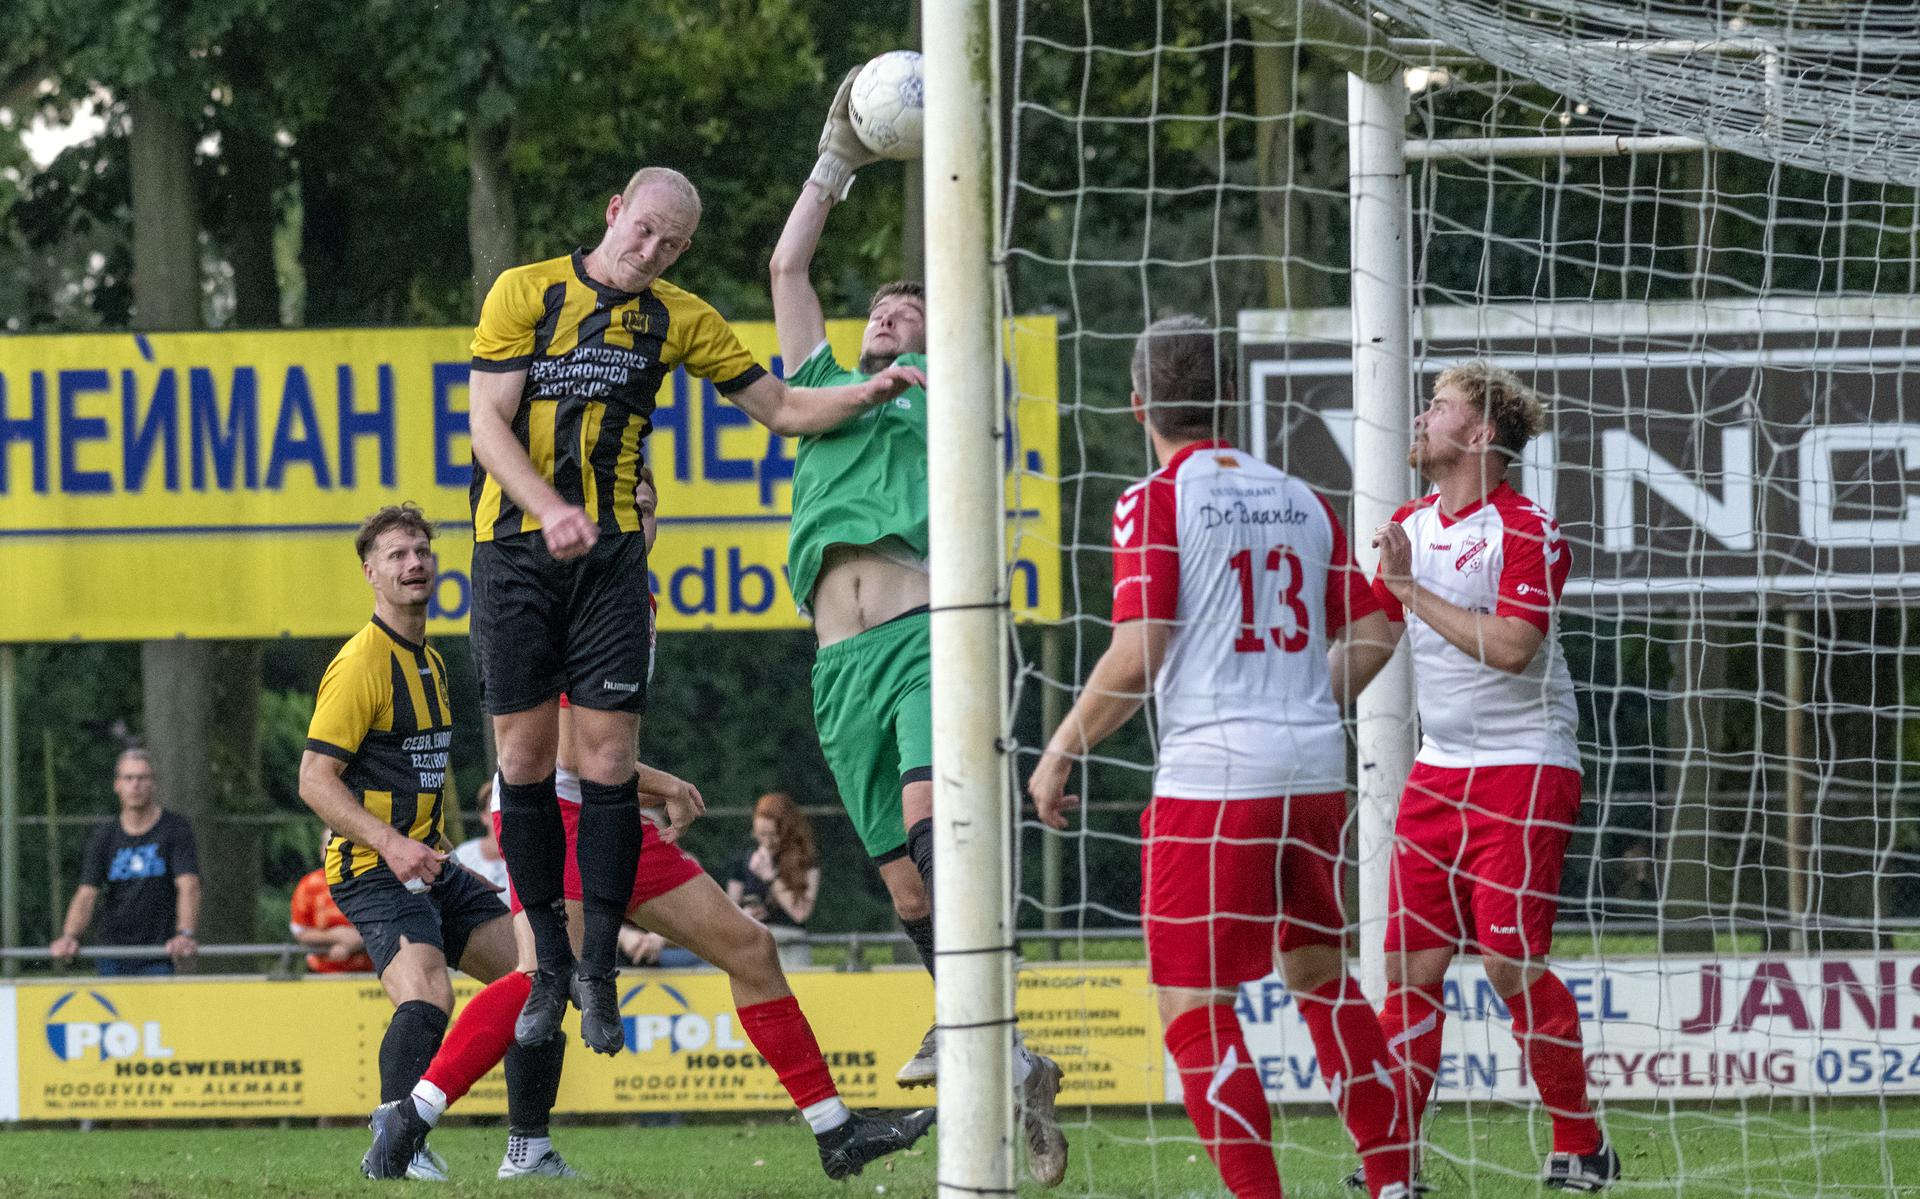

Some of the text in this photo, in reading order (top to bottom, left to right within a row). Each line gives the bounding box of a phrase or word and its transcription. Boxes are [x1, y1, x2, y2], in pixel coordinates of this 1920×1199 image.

[1200, 503, 1233, 529] De
[1229, 544, 1310, 653] 13
[603, 679, 639, 692] hummel
[1680, 961, 1920, 1034] JAN
[66, 1021, 174, 1058] POL
[635, 1013, 746, 1051] POL
[115, 1060, 303, 1077] HOOGWERKERS
[44, 1080, 303, 1097] HOOGEVEEN ALKMAAR
